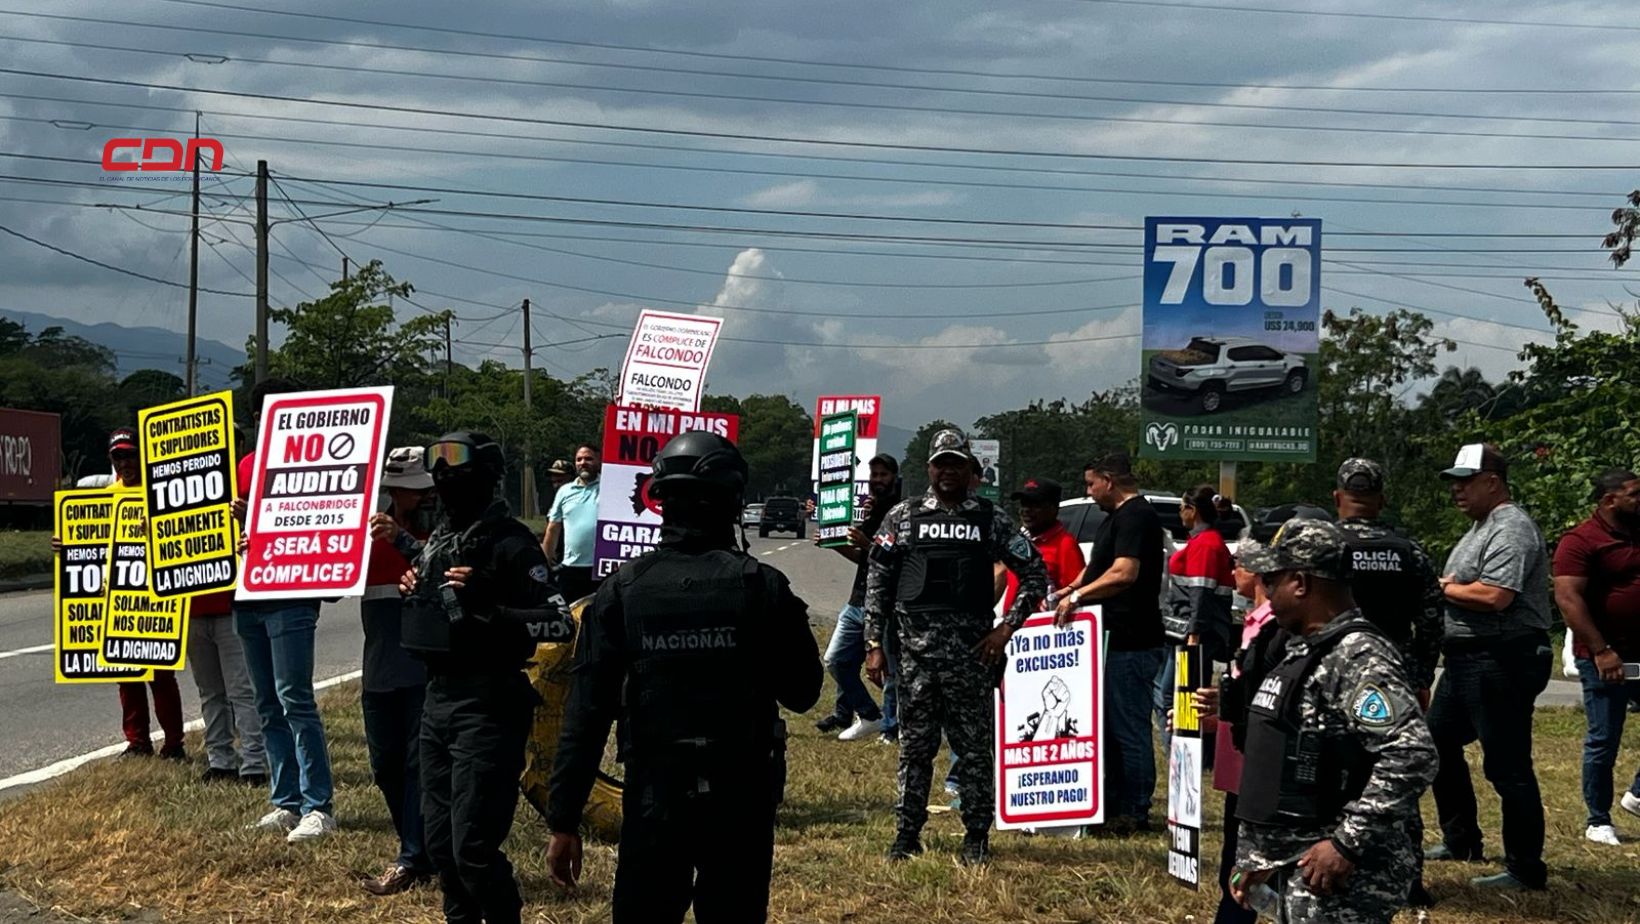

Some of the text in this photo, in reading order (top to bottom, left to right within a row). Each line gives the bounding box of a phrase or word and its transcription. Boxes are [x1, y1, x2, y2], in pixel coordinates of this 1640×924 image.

[1156, 224, 1312, 245] RAM
[1153, 246, 1312, 307] 700
[642, 333, 652, 342] ES
[695, 339, 707, 348] DE
[636, 344, 703, 364] FALCONDO
[631, 373, 692, 391] FALCONDO
[821, 400, 875, 415] EN MI PAIS
[150, 408, 220, 438] CONTRATISTAS
[278, 408, 370, 430] EL GOBIERNO
[616, 410, 729, 438] EN MI PAIS
[1184, 425, 1310, 437] PODER INIGUALABLE
[152, 429, 219, 457] Y SUPLIDORES
[284, 434, 325, 463] NO
[618, 434, 659, 463] NO
[152, 454, 221, 479] HEMOS PERDIDO
[152, 470, 224, 510] TODO
[271, 466, 359, 495] AUDITÓ
[66, 503, 113, 520] CONTRAT
[265, 499, 358, 513] A FALCONBRIDGE
[156, 510, 225, 539] SOLAMENTE
[275, 514, 344, 527] DESDE 2015
[68, 524, 110, 540] Y SUPLID
[122, 524, 127, 538] Y
[918, 524, 981, 542] POLICIA
[67, 548, 97, 561] HEMOS
[118, 546, 145, 557] HEMOS
[159, 532, 225, 561] NOS QUEDA
[262, 532, 353, 561] ¿SERÁ SU
[1352, 549, 1401, 562] OLICÍA
[116, 560, 148, 586] TO
[157, 560, 231, 591] LA DIGNIDAD
[250, 562, 355, 585] CÓMPLICE?
[1352, 560, 1402, 571] ACIONAL
[66, 564, 107, 593] TO
[70, 625, 94, 643] NOS
[113, 616, 173, 634] NOS QUEDA
[106, 640, 176, 660] LA DIGNIDAD
[642, 632, 736, 651] NACIONAL
[1010, 625, 1084, 656] ¡Ya no más
[65, 653, 80, 673] LA
[1016, 649, 1079, 673] excusas!
[1004, 739, 1094, 765] MAS DE 2 AÑOS
[1018, 769, 1079, 789] ¡ESPERANDO
[1010, 788, 1087, 807] NUESTRO PAGO!
